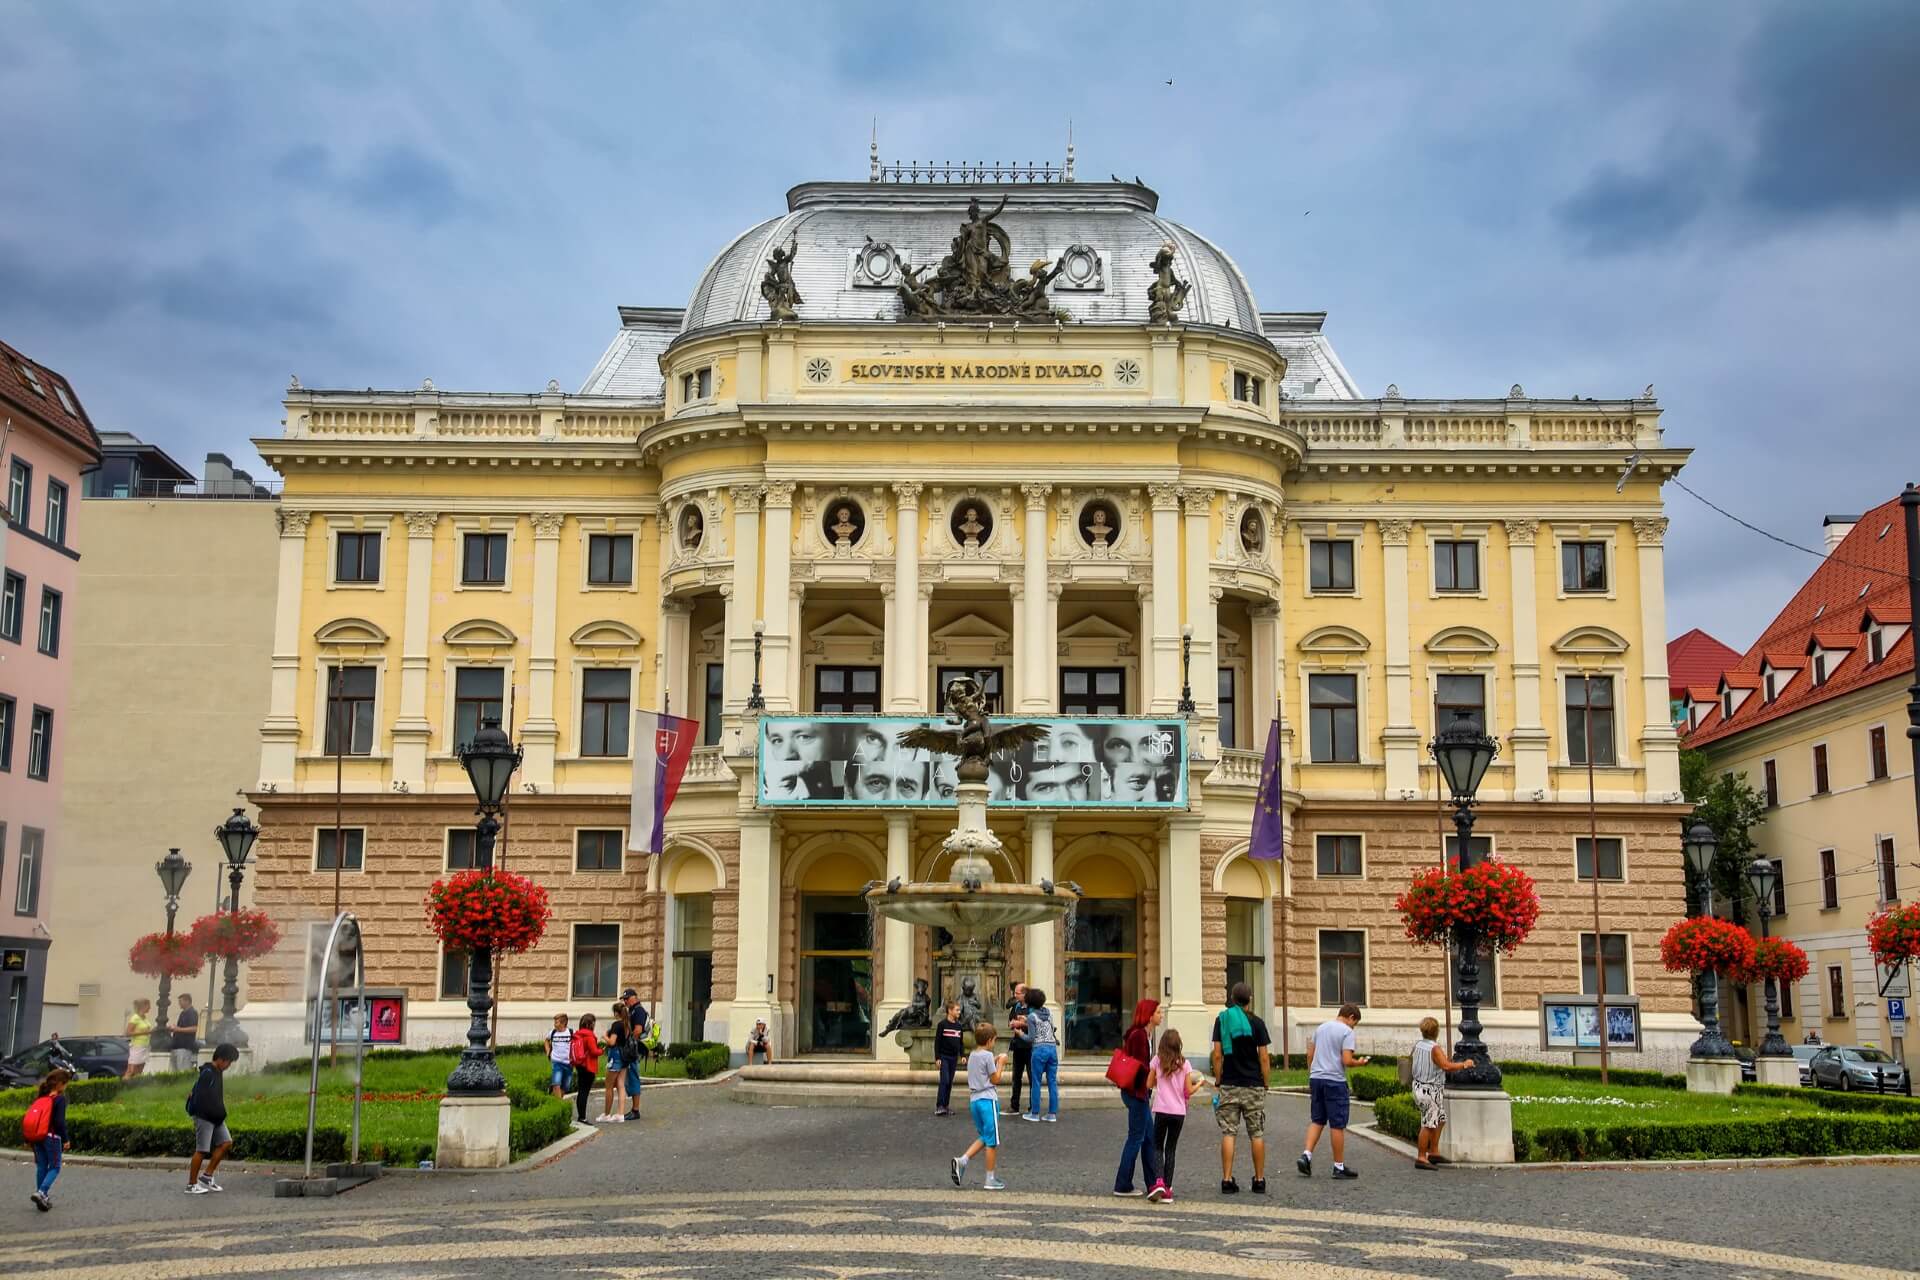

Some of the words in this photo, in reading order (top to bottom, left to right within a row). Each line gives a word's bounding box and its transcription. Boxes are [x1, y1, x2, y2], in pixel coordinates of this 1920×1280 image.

[851, 362, 945, 379] SLOVENSKÉ
[951, 362, 1031, 379] NÁRODNÉ
[1035, 364, 1103, 379] DIVADLO
[1891, 1001, 1900, 1014] P
